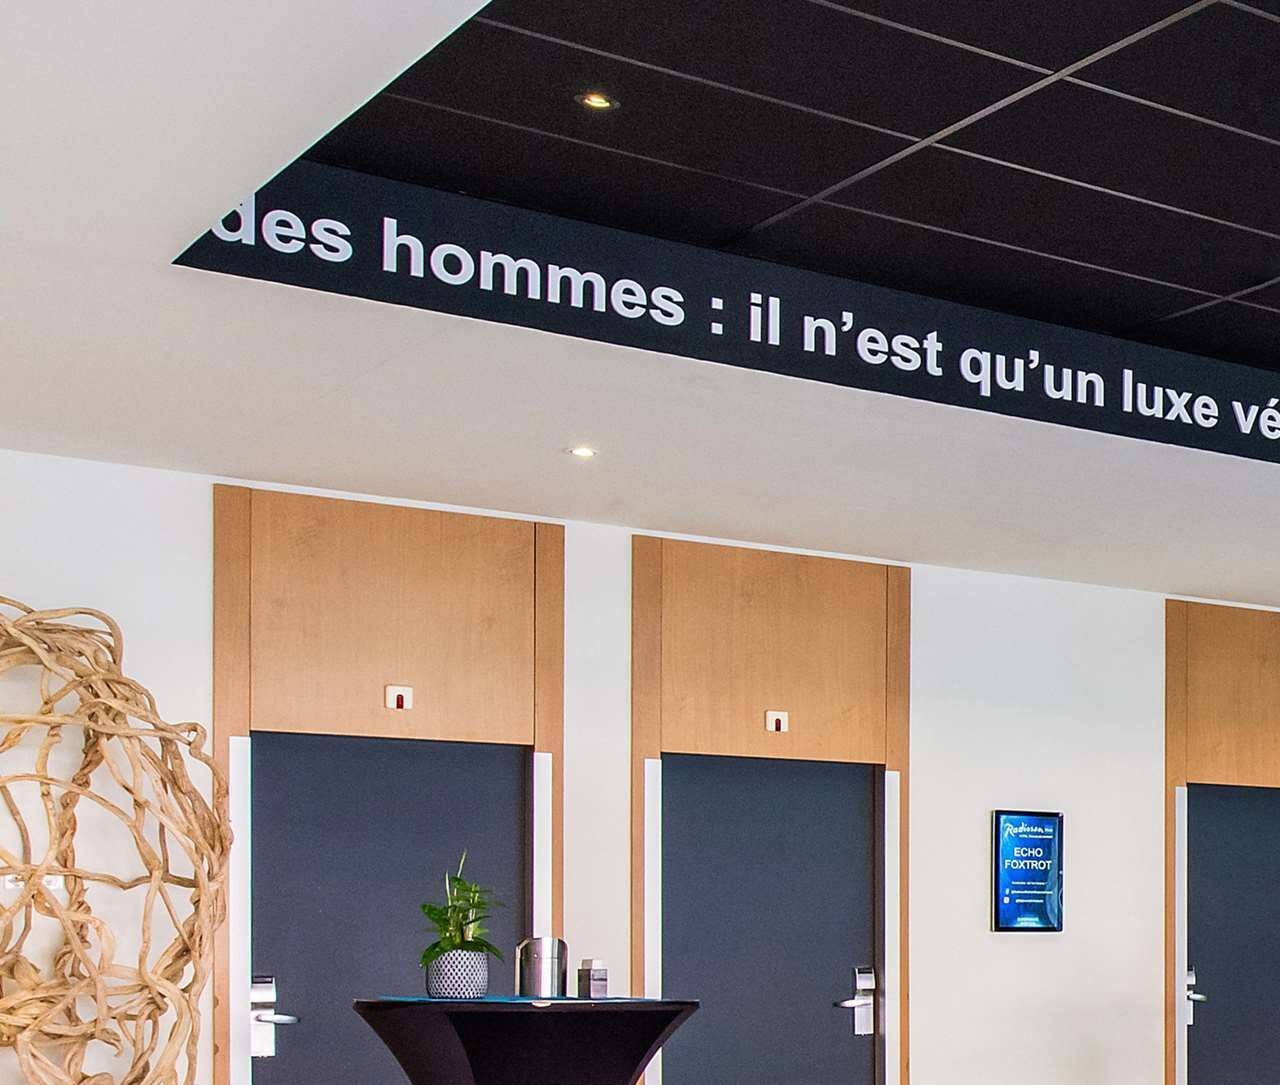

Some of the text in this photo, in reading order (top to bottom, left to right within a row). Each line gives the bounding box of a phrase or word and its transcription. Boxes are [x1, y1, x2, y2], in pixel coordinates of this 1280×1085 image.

[210, 192, 353, 263] des
[382, 216, 686, 326] hommes
[711, 296, 724, 335] :
[749, 292, 781, 346] il
[804, 310, 943, 377] n’est
[959, 348, 1105, 407] qu’un
[1122, 368, 1219, 428] luxe
[1013, 847, 1043, 857] ECHO
[1004, 859, 1052, 870] FOXTROT
